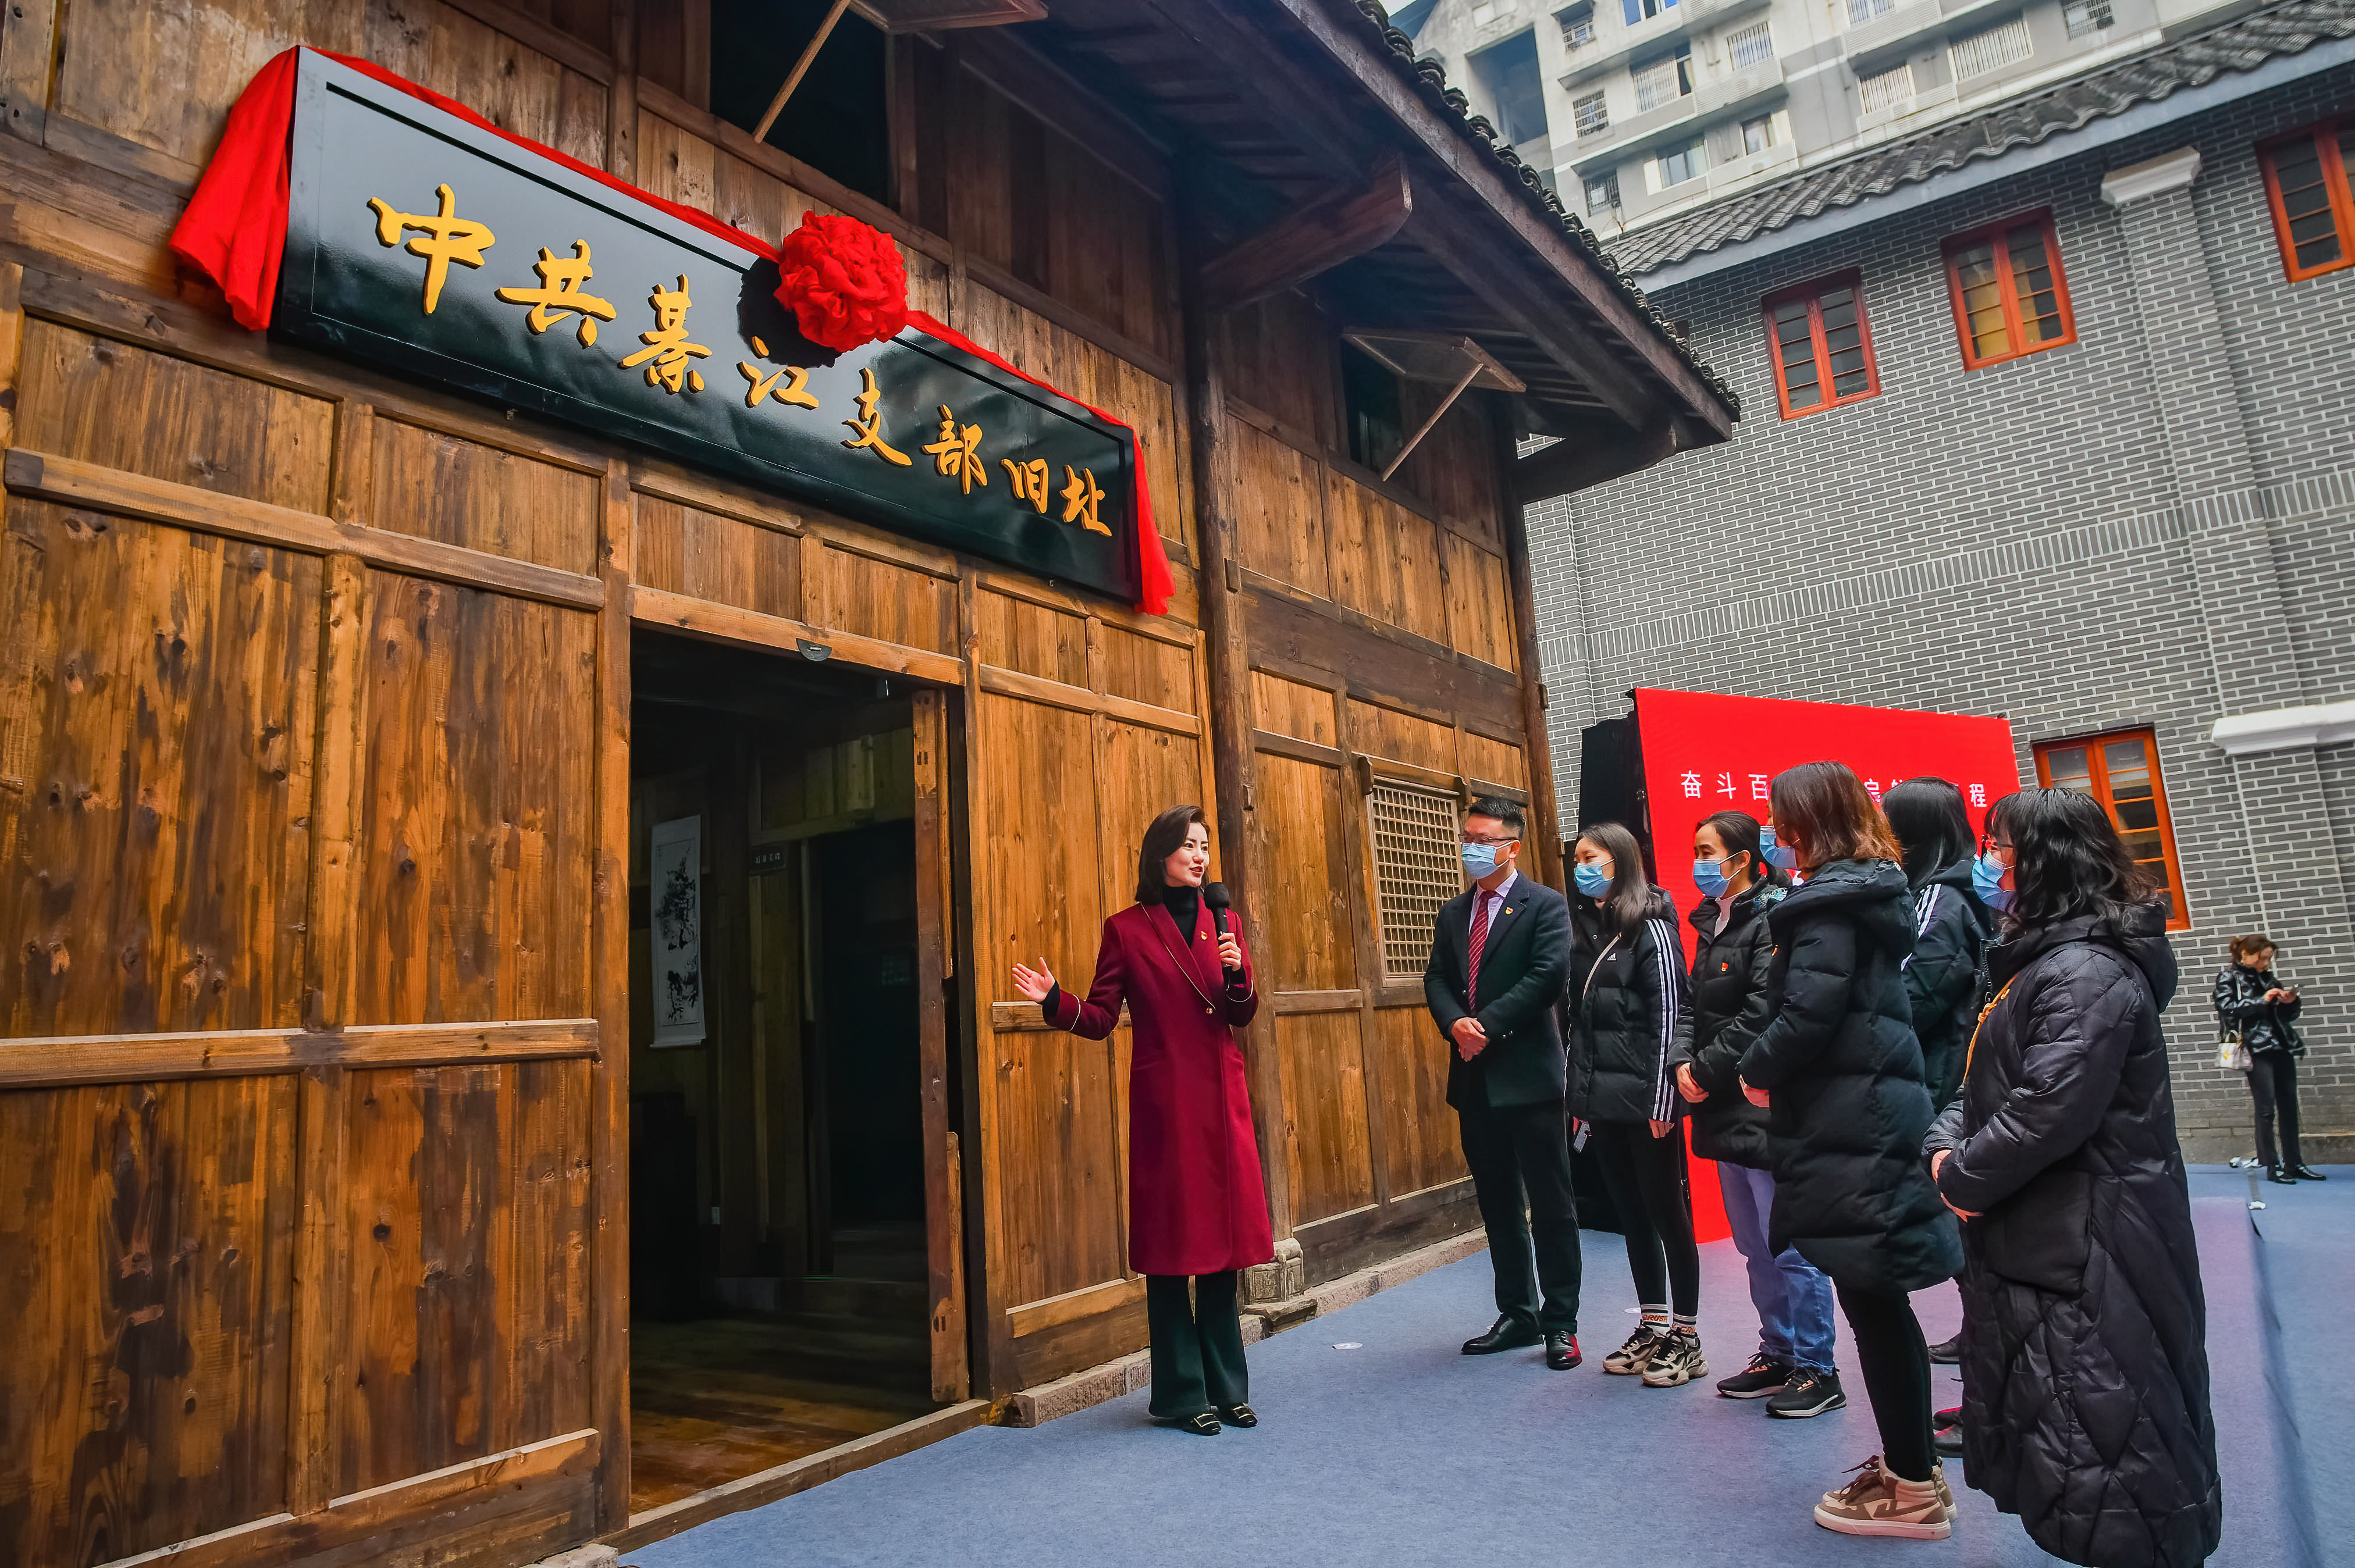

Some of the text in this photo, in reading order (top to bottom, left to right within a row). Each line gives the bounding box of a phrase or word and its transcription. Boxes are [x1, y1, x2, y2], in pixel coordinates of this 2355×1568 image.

[368, 183, 1112, 537] 中共綦江支部旧址
